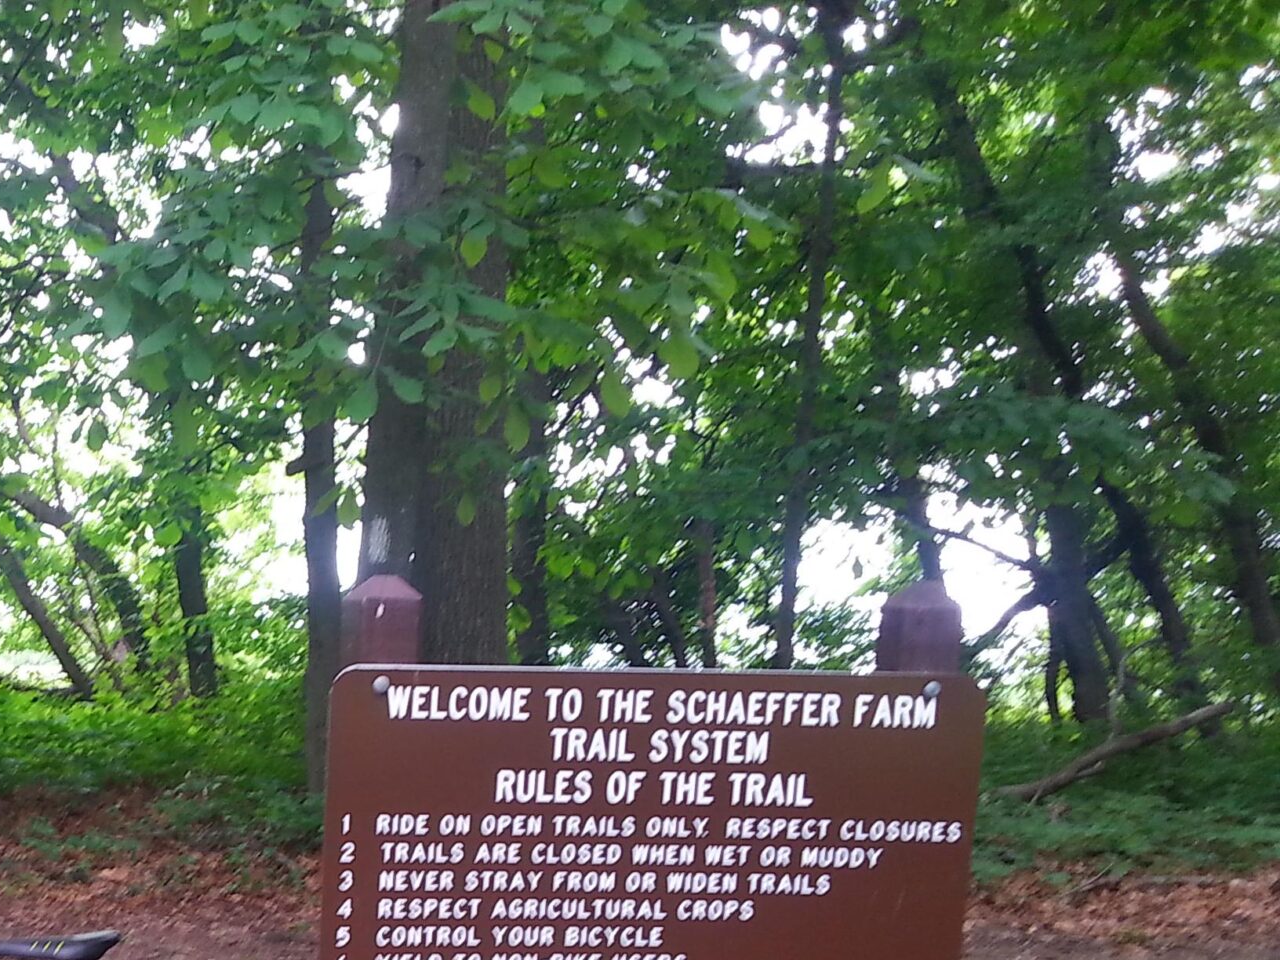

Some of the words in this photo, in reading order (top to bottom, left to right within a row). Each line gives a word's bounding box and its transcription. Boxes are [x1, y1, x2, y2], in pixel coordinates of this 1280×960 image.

[387, 685, 532, 721] WELCOME
[544, 687, 583, 722] TO
[596, 688, 654, 723] THE
[665, 689, 842, 727] SCHAEFFER
[852, 693, 937, 729] FARM
[550, 727, 635, 762] TRAIL
[648, 728, 770, 765] SYSTEM
[495, 769, 593, 804] RULES
[606, 770, 647, 805] OF
[659, 771, 716, 805] THE
[728, 772, 814, 807] TRAIL
[342, 813, 351, 835] 1
[375, 813, 430, 835] RIDE
[439, 814, 471, 836] ON
[480, 814, 543, 836] OPEN
[552, 815, 636, 837] TRAILS
[725, 817, 832, 840] RESPECT
[839, 819, 961, 843] CLOSURES
[339, 841, 355, 863] 2
[380, 842, 464, 864] TRAILS
[473, 842, 522, 864] ARE
[531, 842, 622, 865] CLOSED
[631, 844, 696, 866] WHEN
[704, 845, 752, 867] WET
[759, 845, 792, 867] OR
[800, 846, 884, 869] MUDDY
[338, 870, 353, 892] 3
[378, 870, 455, 892] NEVER
[464, 870, 544, 892] STRAY
[552, 871, 616, 893] FROM
[625, 871, 657, 893] OR
[666, 872, 738, 894] WIDEN
[746, 873, 831, 895] TRAILS
[336, 898, 353, 919] 4
[377, 898, 482, 920] RESPECT
[490, 898, 668, 920] AGRICULTURAL
[676, 899, 754, 921] CROPS
[335, 926, 351, 948] 5
[375, 925, 481, 947] CONTROL
[491, 925, 555, 947] YOUR
[563, 926, 664, 947] BICYCLE
